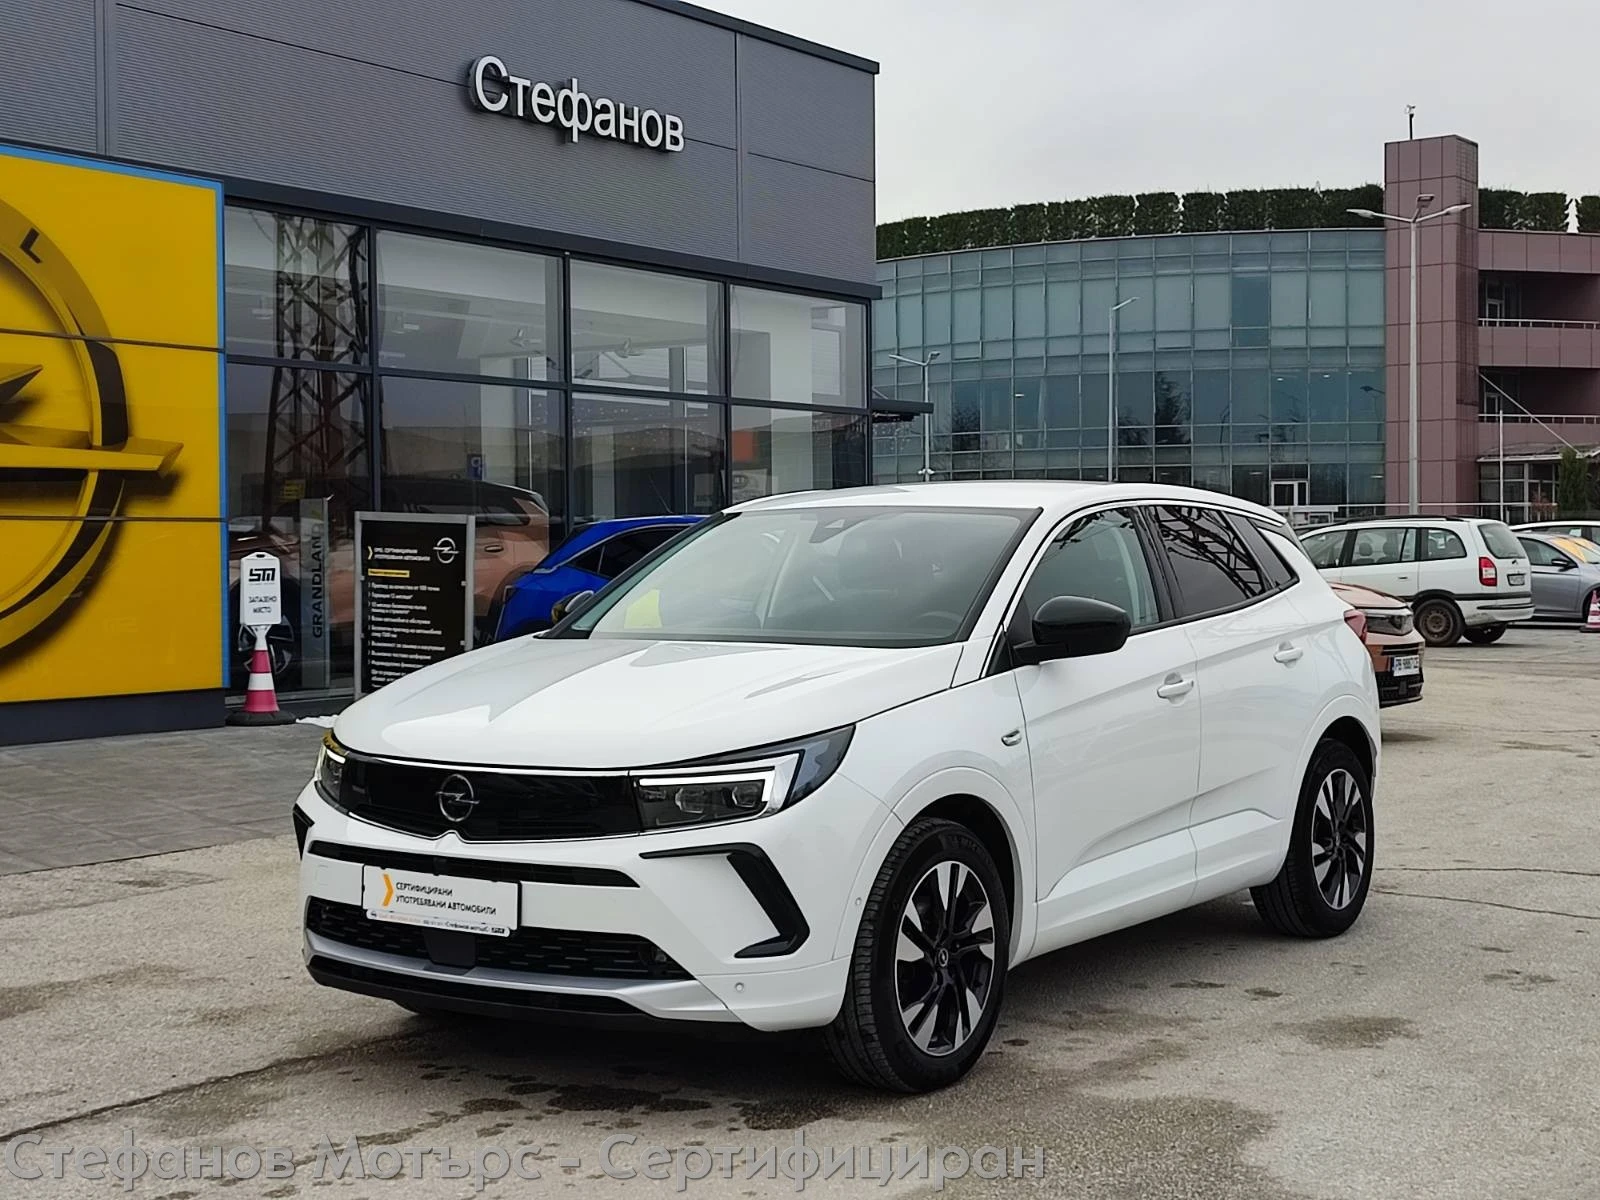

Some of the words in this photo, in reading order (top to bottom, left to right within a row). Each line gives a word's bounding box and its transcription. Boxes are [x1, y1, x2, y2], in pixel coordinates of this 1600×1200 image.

[474, 55, 685, 152] Стефанов
[311, 523, 323, 638] GRANDLAND
[395, 881, 453, 897] СЕРТИФИЦИРАНИ
[395, 895, 447, 909] УПОТРЕБЯВАНИ
[447, 902, 497, 915] АВТОМОБИЛИ
